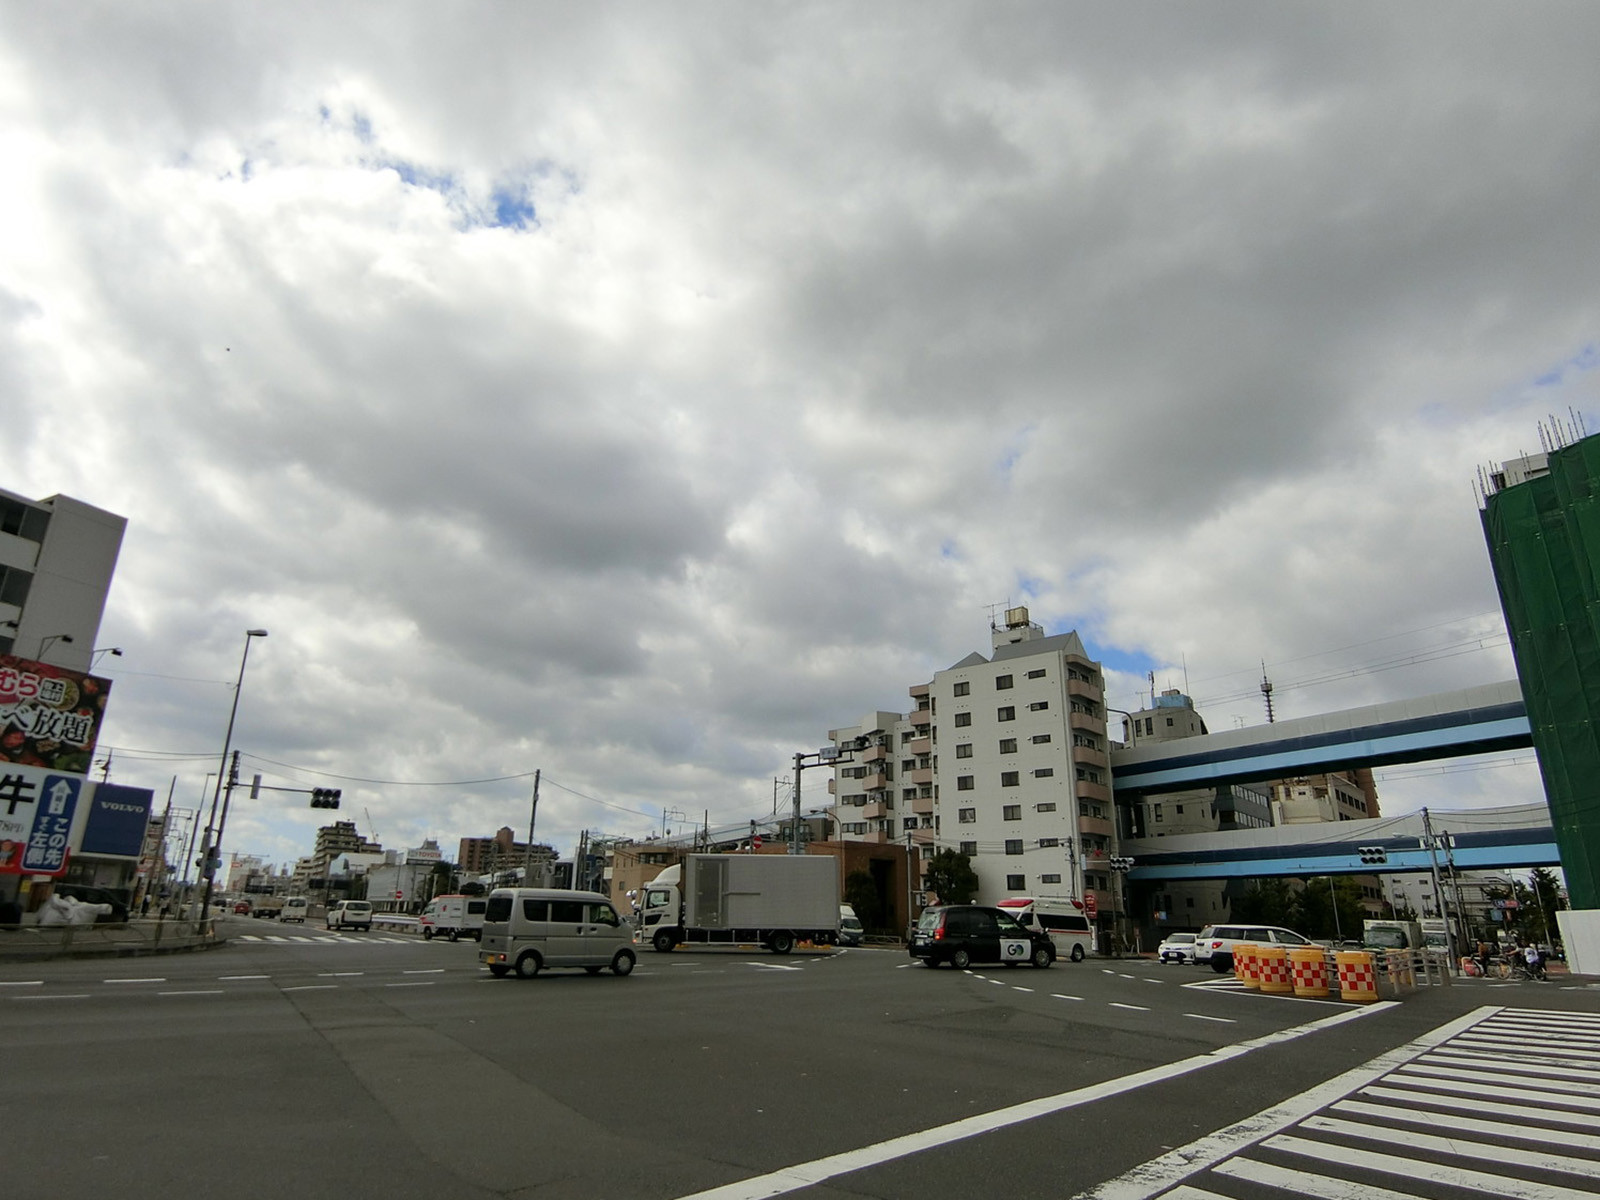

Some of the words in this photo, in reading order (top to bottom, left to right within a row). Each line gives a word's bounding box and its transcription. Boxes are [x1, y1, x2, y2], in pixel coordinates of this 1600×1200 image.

[2, 706, 91, 744] べ放題
[0, 774, 35, 815] 牛
[100, 801, 145, 813] VOLVO
[43, 817, 69, 865] この先
[1007, 944, 1024, 956] GO
